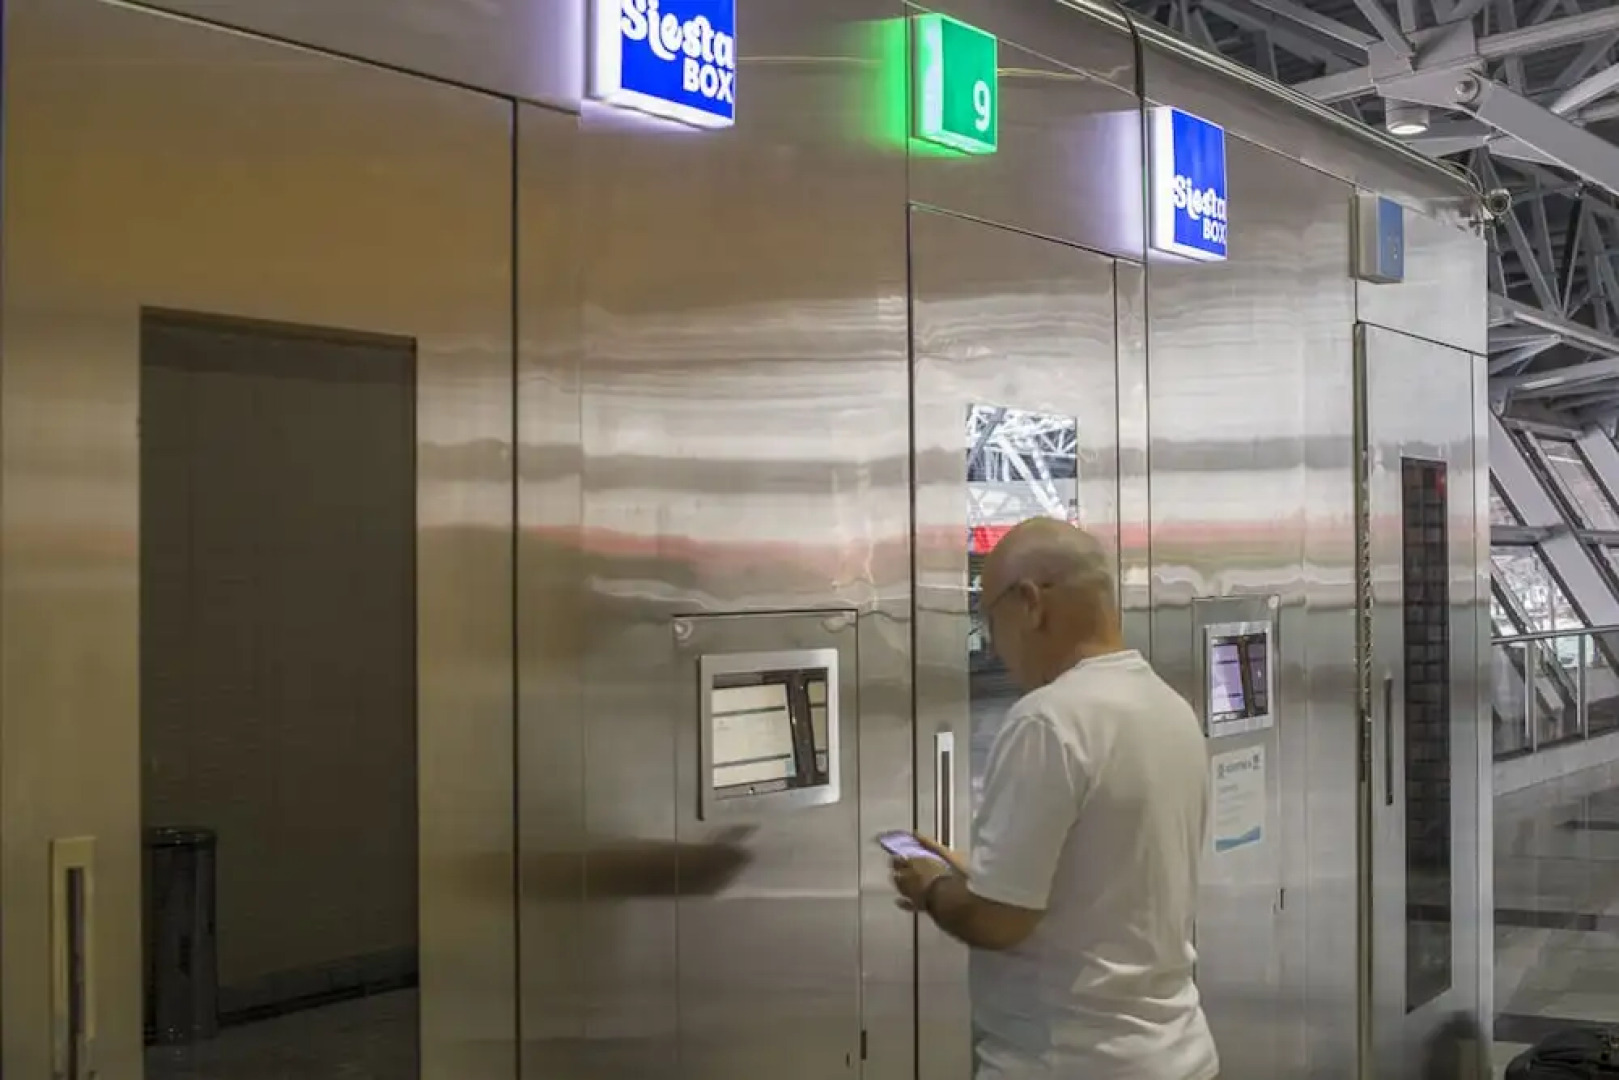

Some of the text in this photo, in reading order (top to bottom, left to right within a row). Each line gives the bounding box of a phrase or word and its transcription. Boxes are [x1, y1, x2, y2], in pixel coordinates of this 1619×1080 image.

[621, 0, 735, 69] Siesta
[682, 57, 734, 104] BOX
[973, 80, 991, 132] 9
[1172, 174, 1227, 221] Siesta
[1203, 217, 1227, 245] BOX
